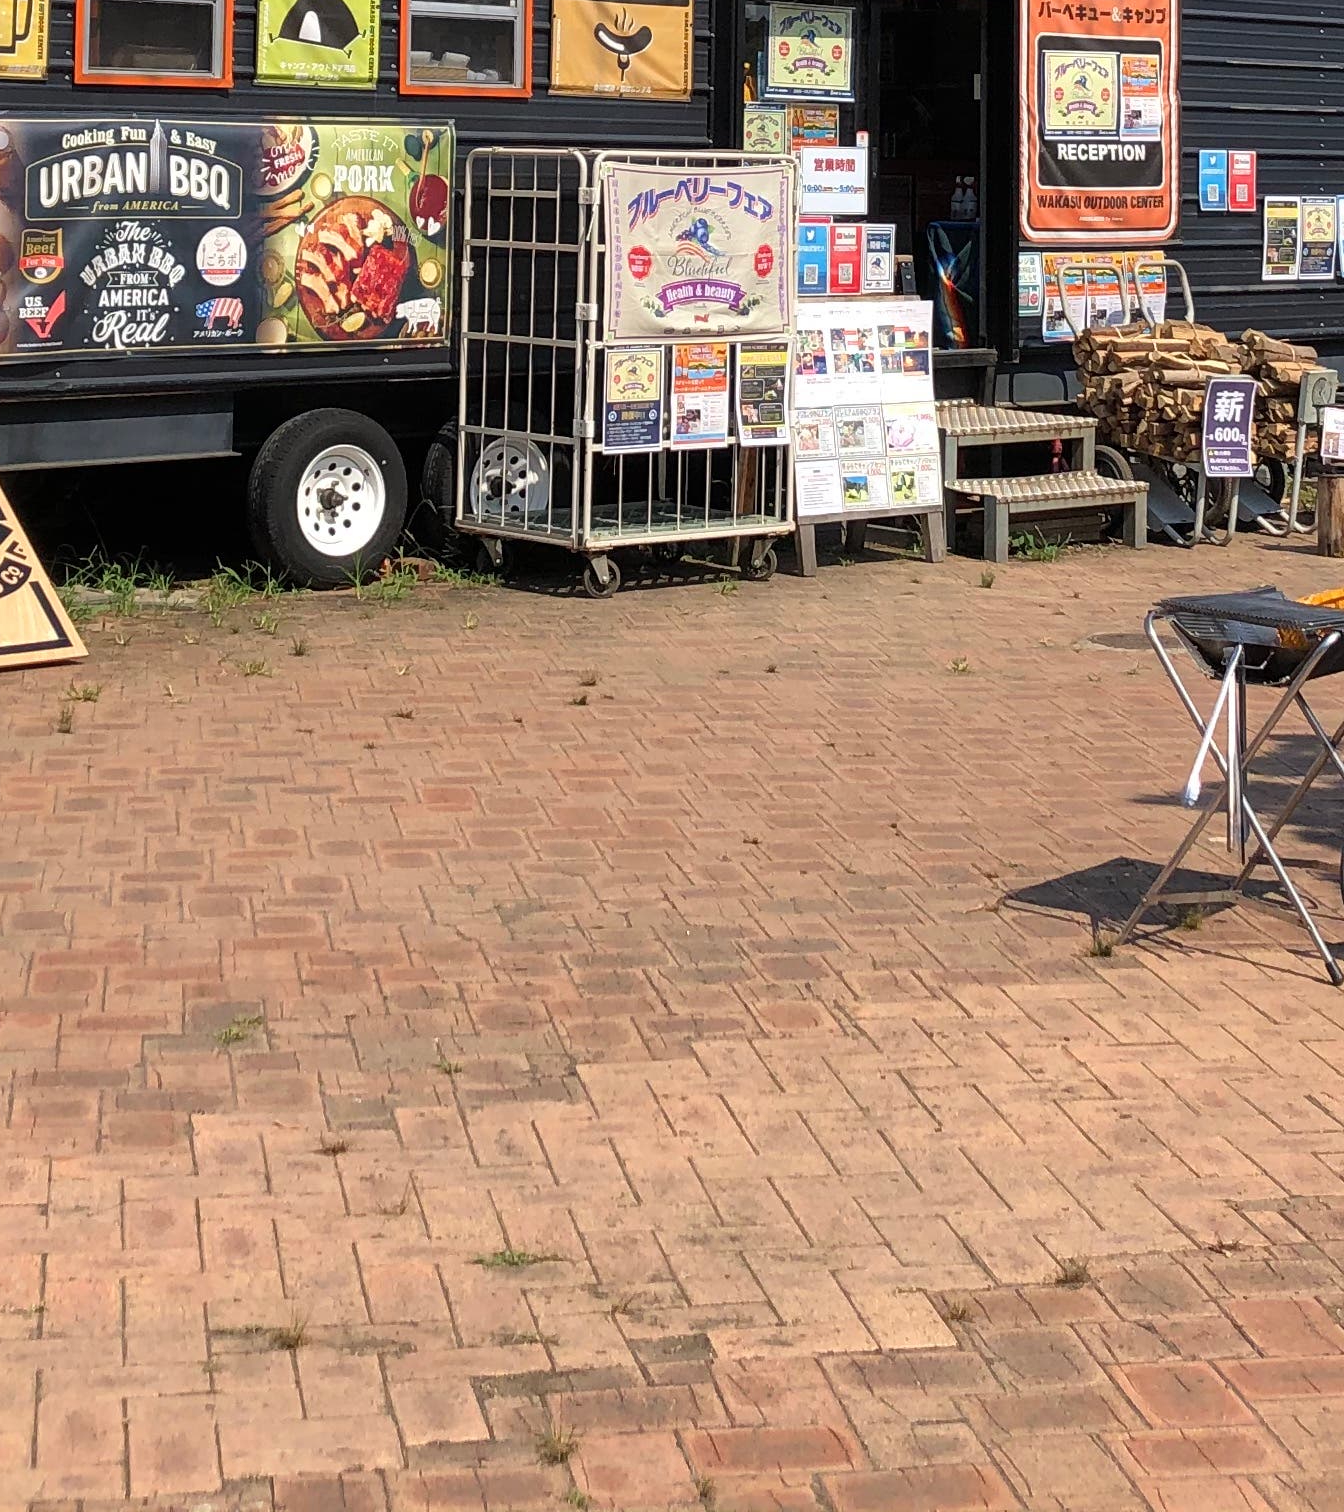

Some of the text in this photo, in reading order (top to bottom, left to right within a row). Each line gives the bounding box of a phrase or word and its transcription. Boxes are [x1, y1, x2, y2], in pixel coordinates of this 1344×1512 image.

[1038, 1, 1167, 24] バーベキュー&キャンプ
[62, 126, 217, 155] Cooking Fun & Easy
[331, 128, 399, 153] TASTE IT
[1057, 143, 1146, 162] RECEPTION
[814, 158, 856, 172] 営業時間
[39, 152, 231, 210] URBAN BBQ
[333, 164, 395, 193] PORK
[90, 200, 180, 213] from AMERICA
[1036, 194, 1165, 210] WAKASU OUTDOOR CENTER
[115, 220, 152, 242] The
[26, 243, 56, 256] Beef
[80, 242, 186, 288] URBAN BBQ
[119, 272, 150, 286] FROM
[98, 288, 170, 308] AMERICA
[665, 284, 695, 303] Health
[695, 283, 704, 297] &
[18, 307, 50, 319] BEEF
[92, 309, 171, 349] Real
[1213, 390, 1245, 423] 薪
